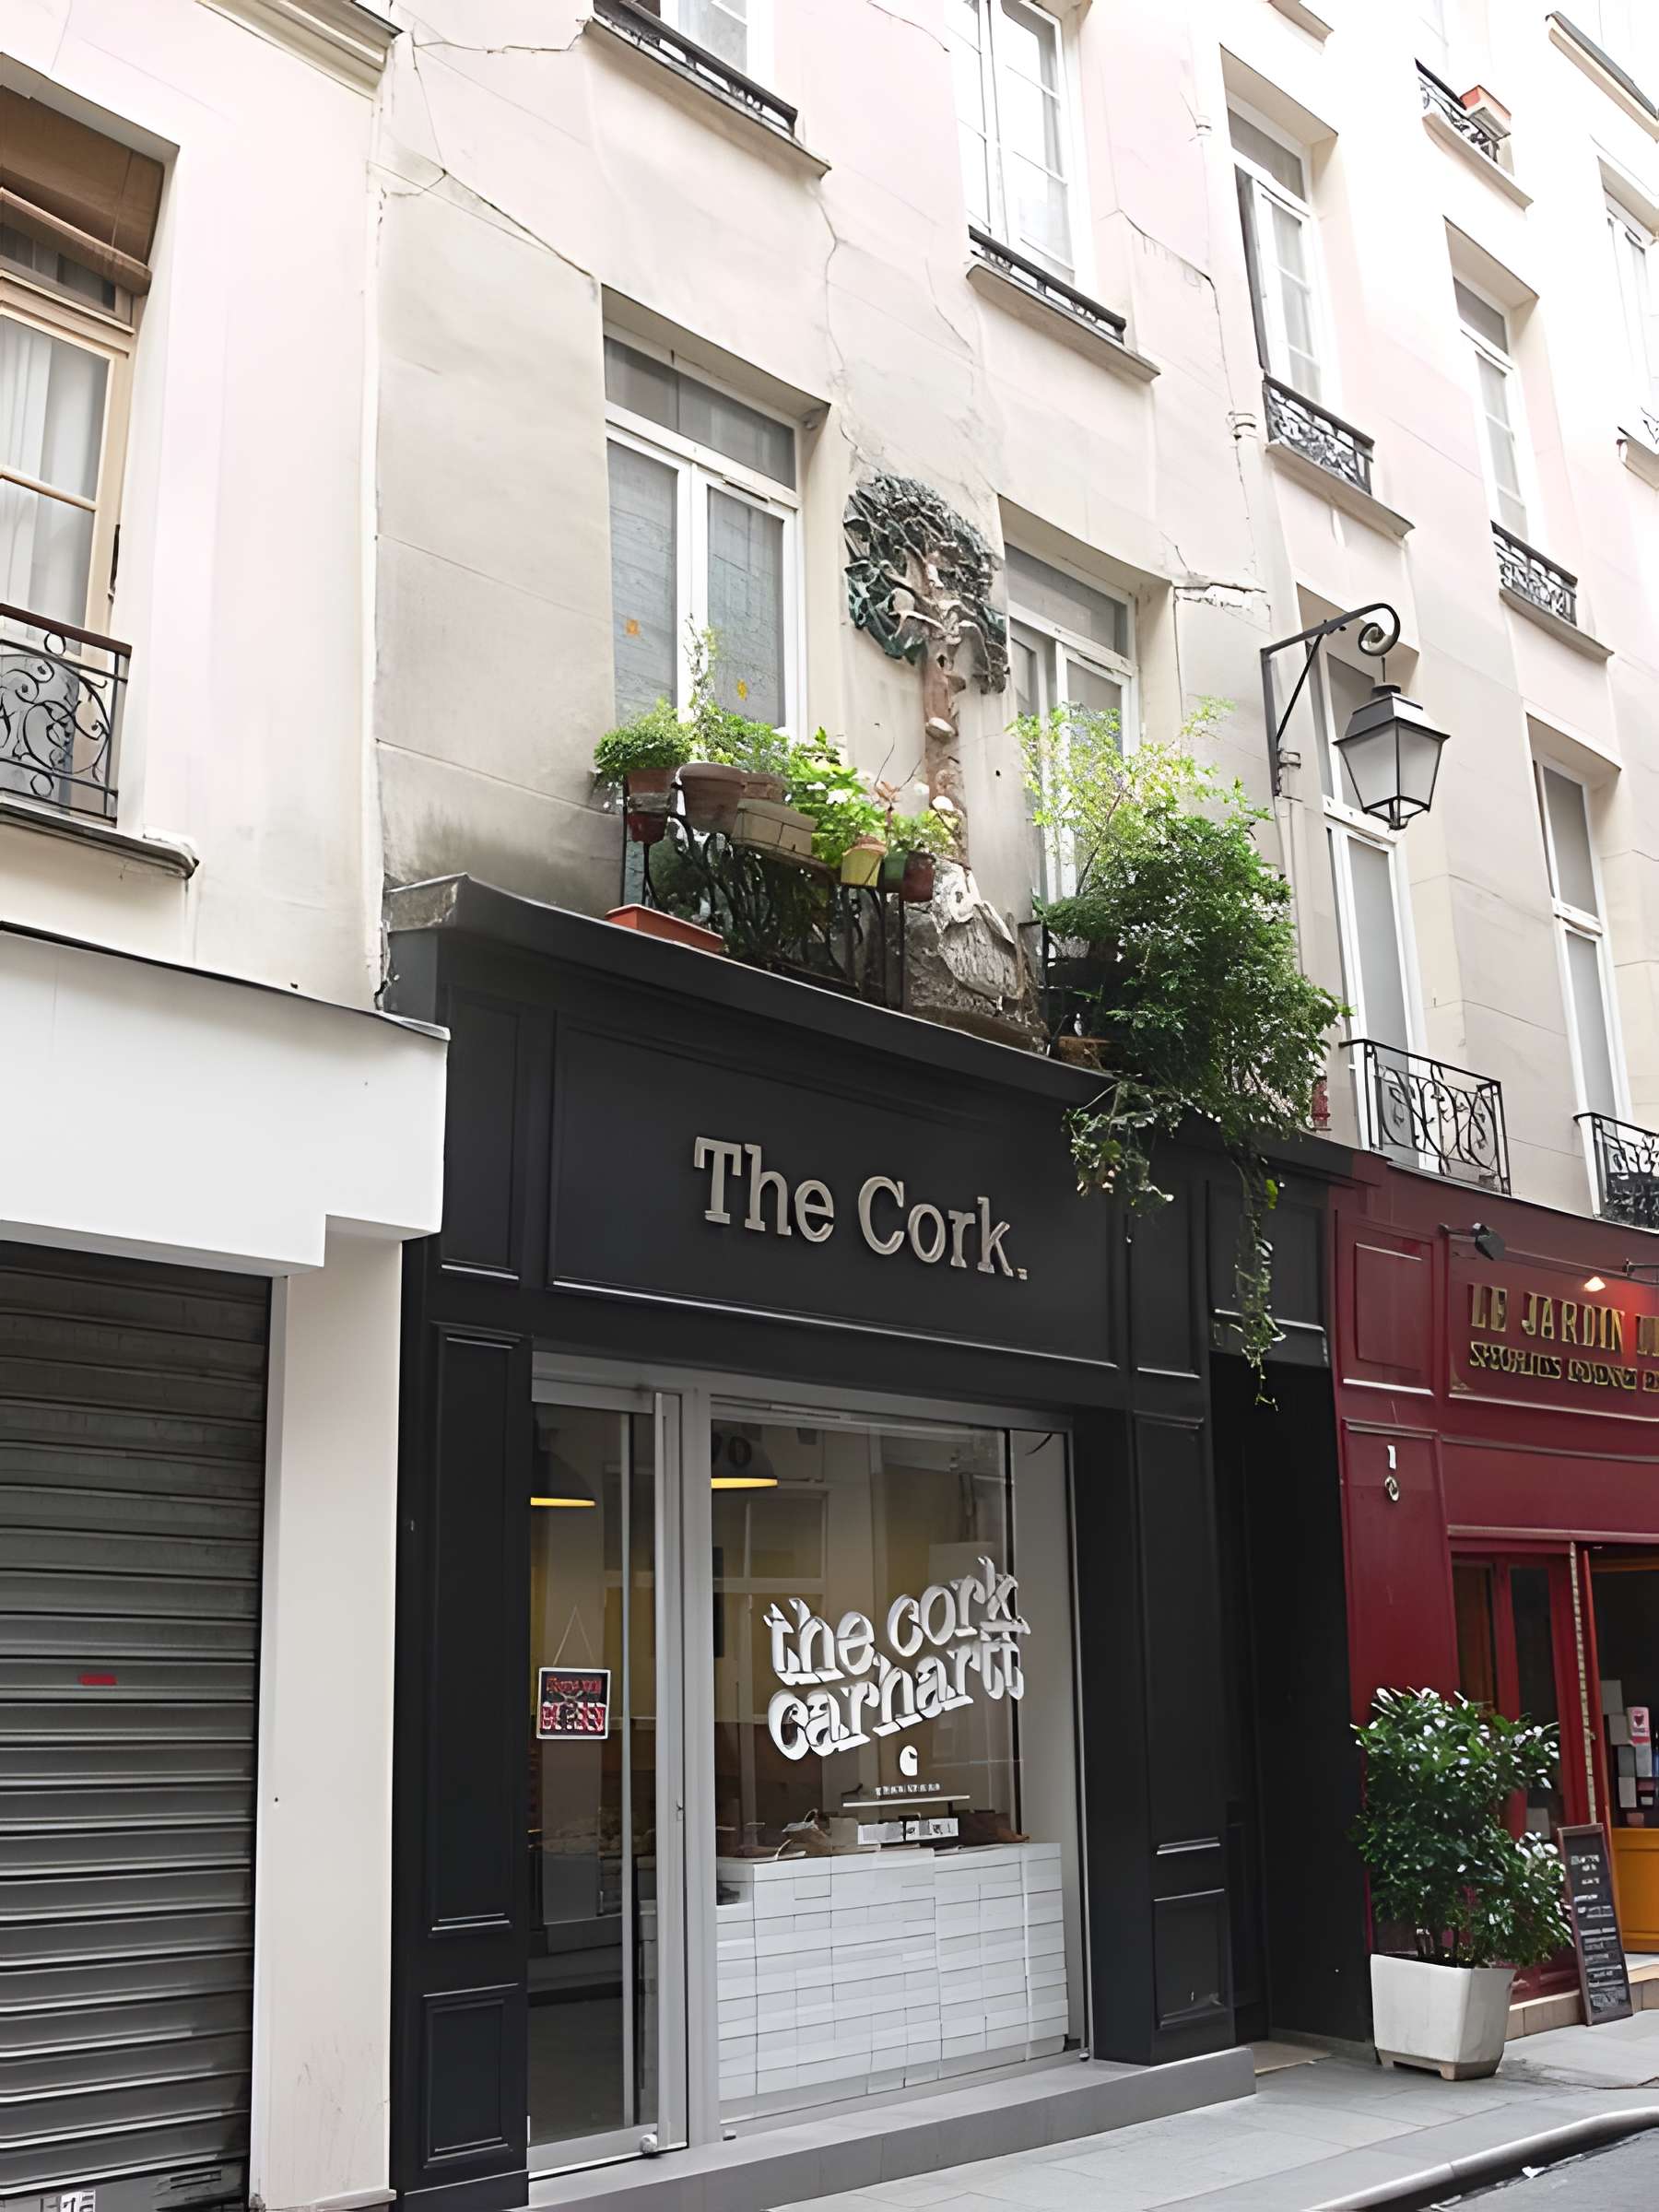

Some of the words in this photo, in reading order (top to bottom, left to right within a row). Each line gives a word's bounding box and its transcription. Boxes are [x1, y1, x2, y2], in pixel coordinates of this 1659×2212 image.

[693, 1135, 835, 1243] The
[857, 1175, 1029, 1281] Cork.
[1467, 1282, 1508, 1333] LE
[1521, 1290, 1626, 1354] JARDIN
[762, 1596, 876, 1687] the
[886, 1555, 1032, 1658] cork
[767, 1630, 1026, 1761] carhartt
